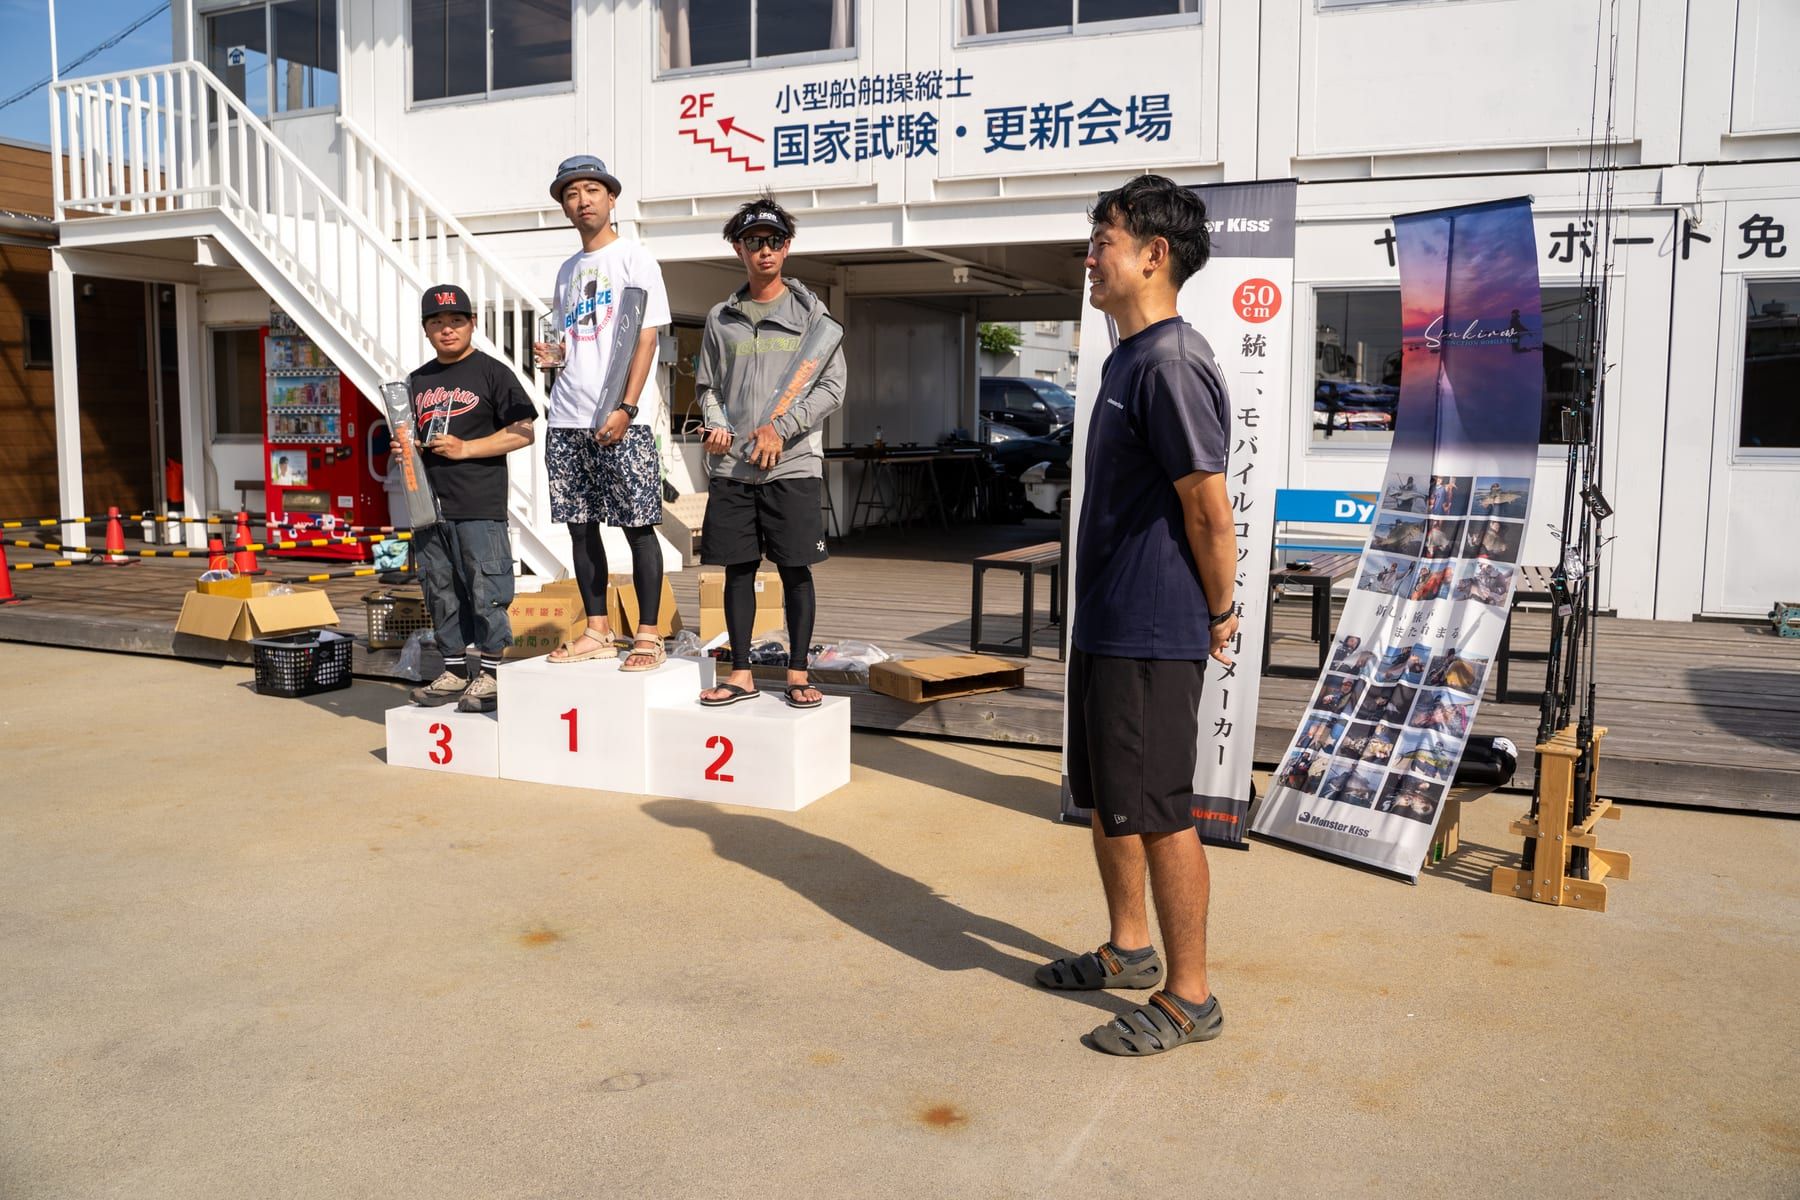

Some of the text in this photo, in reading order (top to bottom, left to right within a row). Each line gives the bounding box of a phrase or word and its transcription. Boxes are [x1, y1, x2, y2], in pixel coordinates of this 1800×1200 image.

[680, 92, 715, 119] 2F
[775, 69, 974, 115] 小型船舶操縦士
[773, 94, 1173, 168] 国家試験・更新会場
[1227, 217, 1271, 233] Kiss
[434, 291, 457, 305] VH
[1240, 285, 1275, 306] 50
[1243, 307, 1270, 319] cm
[428, 722, 453, 765] 3
[560, 707, 578, 753] 1
[704, 735, 734, 783] 2
[1310, 815, 1371, 838] Monster Kiss
